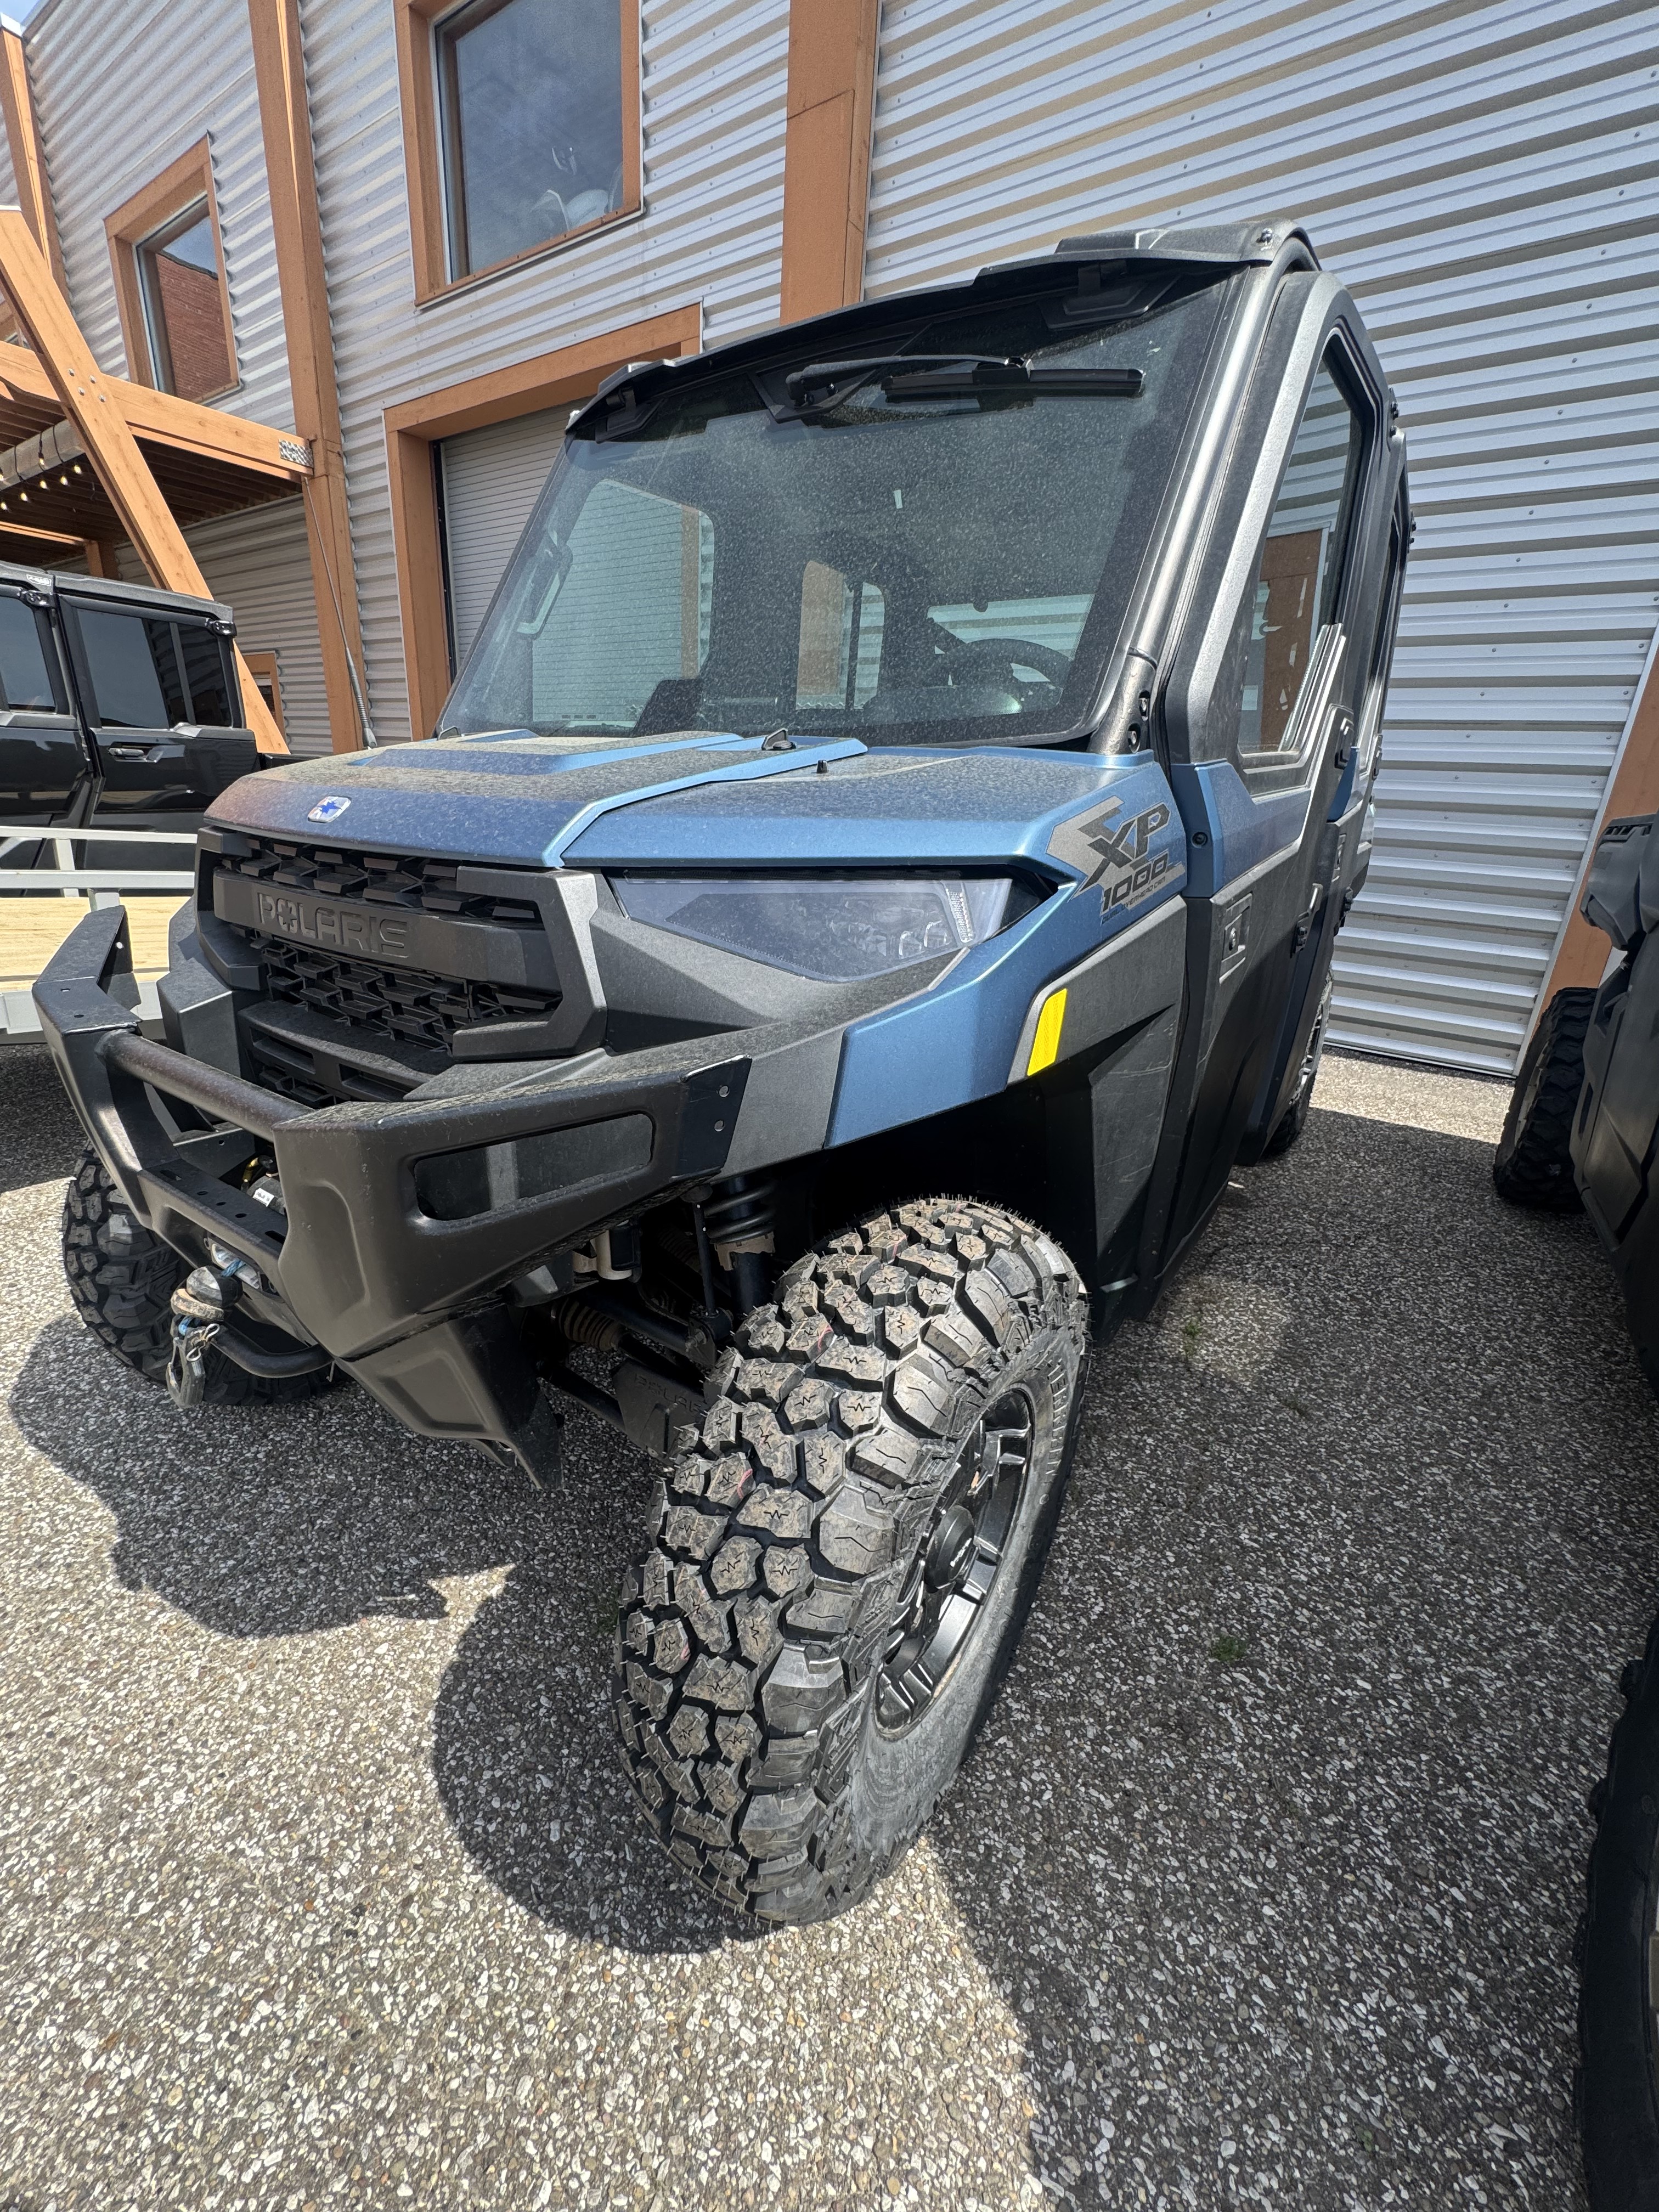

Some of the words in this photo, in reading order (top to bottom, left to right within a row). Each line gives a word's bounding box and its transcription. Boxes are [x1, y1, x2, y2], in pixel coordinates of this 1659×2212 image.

[1079, 803, 1170, 893] XP
[1102, 853, 1169, 912] 1000
[1121, 884, 1154, 909] OVERHEAD
[1154, 876, 1166, 888] CAM
[257, 892, 409, 958] POLARIS
